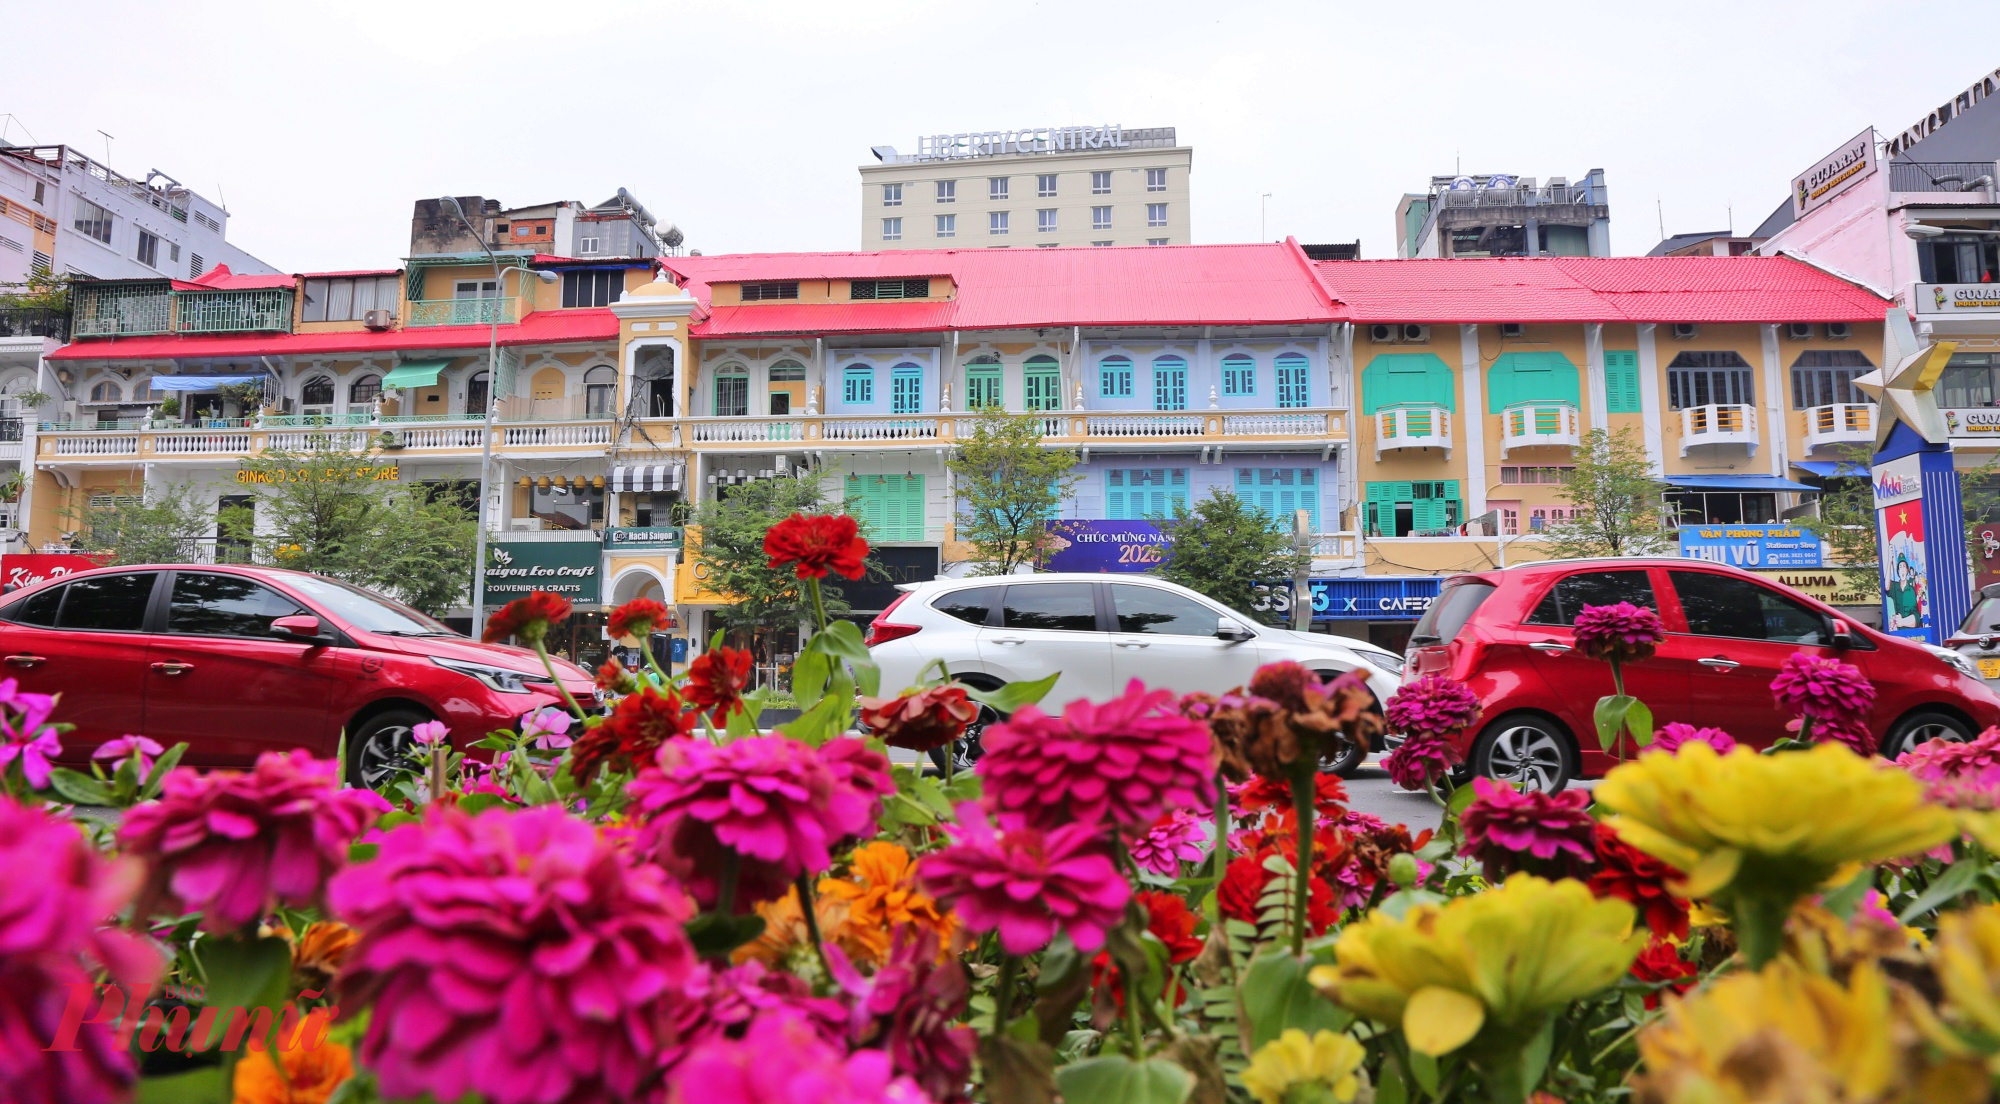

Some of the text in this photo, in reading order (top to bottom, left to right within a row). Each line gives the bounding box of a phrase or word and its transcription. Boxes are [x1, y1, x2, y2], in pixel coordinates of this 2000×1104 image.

[918, 124, 1130, 160] LIBERTY CENTRAL
[1809, 141, 1866, 189] GUJARAT
[1811, 183, 1830, 200] INDIAN
[1872, 469, 1901, 500] Vikki
[629, 531, 648, 540] Hachi
[649, 531, 673, 541] Saigon
[1077, 531, 1109, 543] CHÚC
[1111, 531, 1146, 543] MỪNG
[1730, 540, 1760, 566] VŨ
[1766, 542, 1817, 550] Stationery Shop
[10, 567, 44, 588] Kim
[529, 566, 555, 577] Eco
[557, 565, 595, 578] Craft
[487, 584, 537, 592] SOUVENIRS
[547, 584, 581, 592] CRAFTS
[1778, 575, 1837, 587] ALLUVIA
[1250, 585, 1330, 612] GS5
[1831, 592, 1867, 601] House
